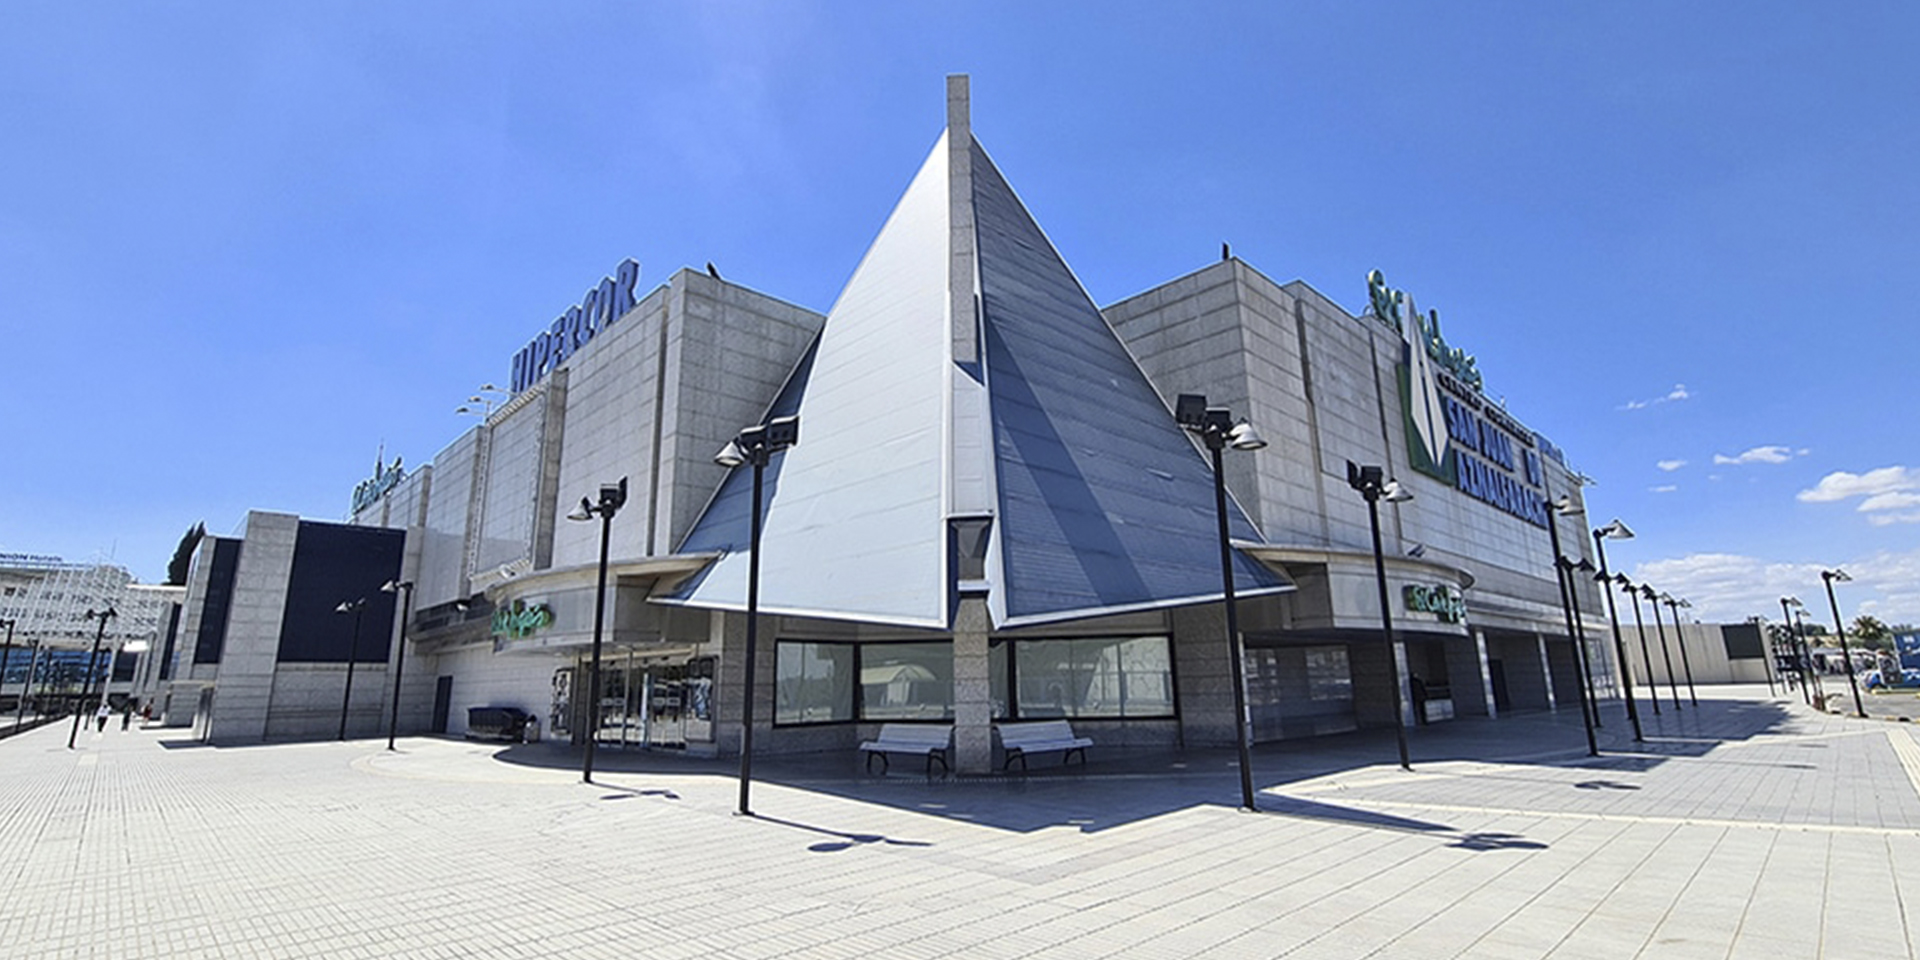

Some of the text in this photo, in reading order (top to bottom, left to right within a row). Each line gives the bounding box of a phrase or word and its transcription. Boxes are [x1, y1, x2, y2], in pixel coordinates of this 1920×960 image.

[510, 258, 639, 393] HIPERCOR
[1447, 395, 1477, 452] SAN
[1478, 418, 1515, 473] JUAN
